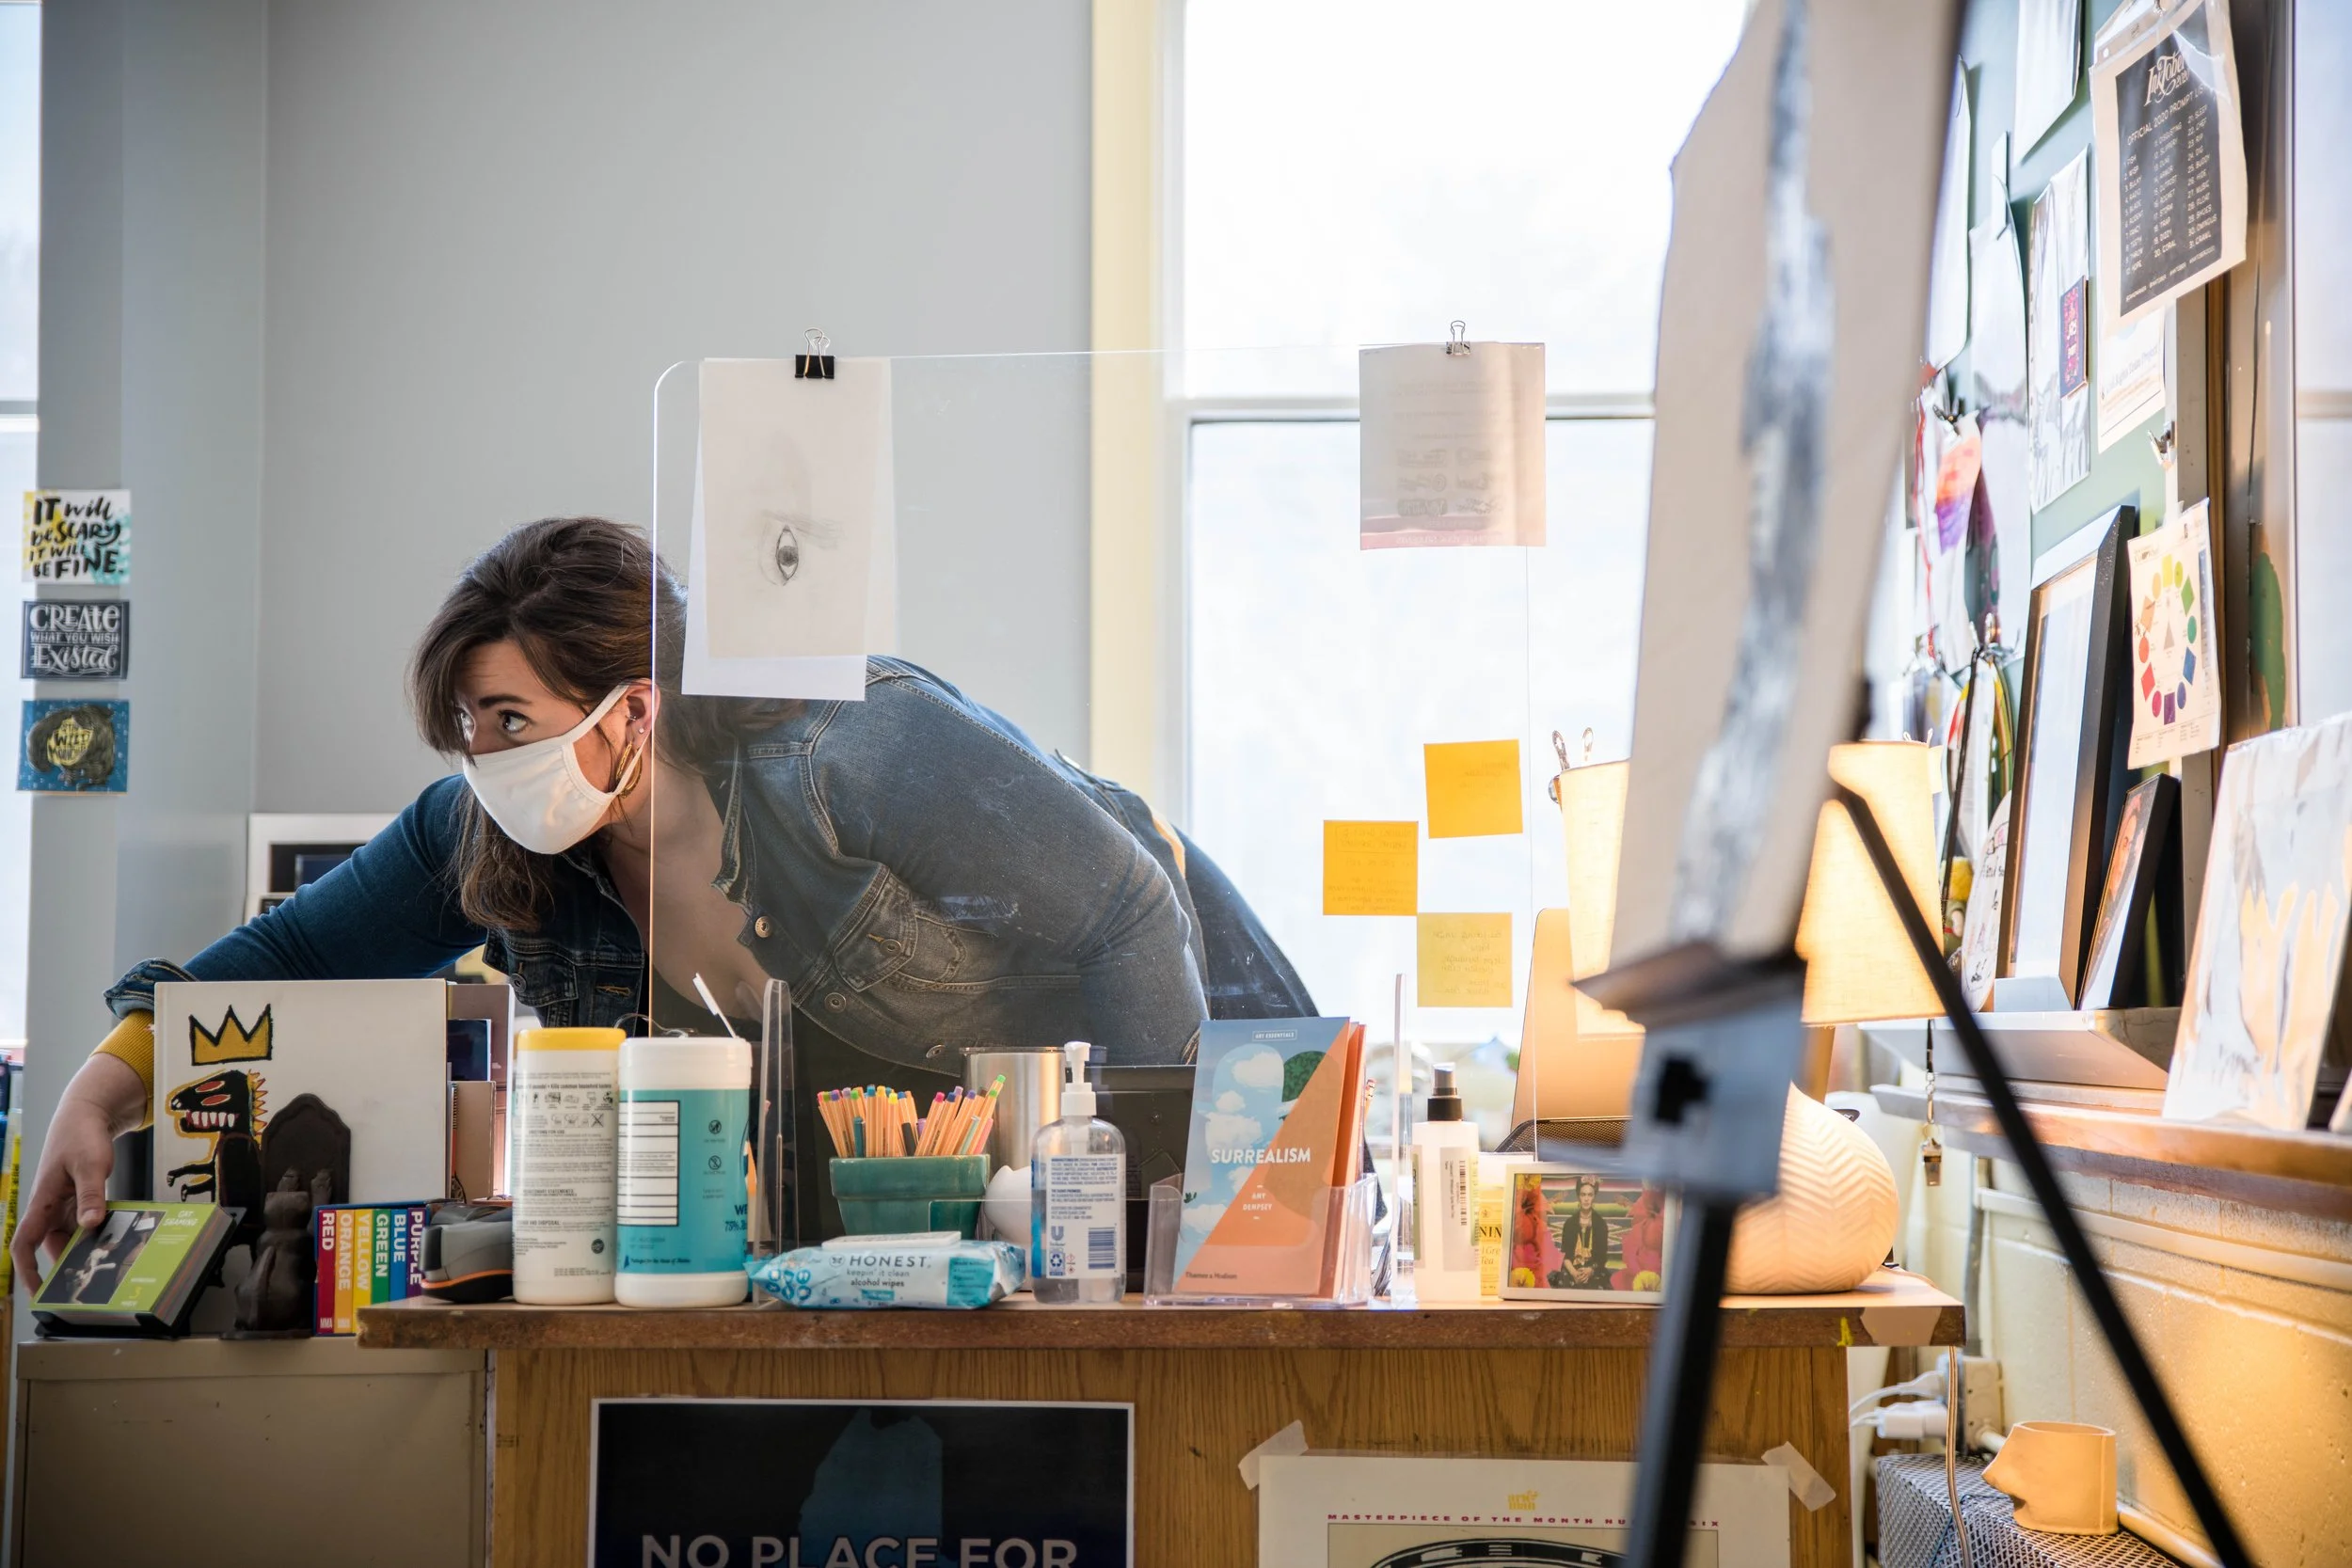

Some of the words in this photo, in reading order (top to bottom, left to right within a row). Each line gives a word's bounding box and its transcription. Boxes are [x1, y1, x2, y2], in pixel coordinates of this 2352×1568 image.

[2127, 124, 2153, 145] OFFICIAL
[2153, 111, 2169, 128] 2020
[2169, 95, 2193, 116] PROMPT
[2162, 240, 2176, 253] CORAL
[34, 497, 61, 526] IT
[64, 496, 113, 520] will
[29, 547, 45, 562] IT
[33, 562, 51, 578] BE
[30, 631, 61, 643] WHAT
[65, 632, 87, 644] YOU
[91, 632, 119, 644] WISH
[30, 643, 119, 671] Existed
[1211, 1147, 1311, 1164] SURREALISM
[1251, 1192, 1265, 1200] AMY
[1242, 1203, 1273, 1212] DEMPSEY
[322, 1212, 335, 1251] RED
[393, 1213, 406, 1263] BLUE
[338, 1213, 353, 1291] ORANGE
[357, 1212, 371, 1291] YELLOW
[375, 1213, 389, 1277] GREEN
[887, 1269, 911, 1277] clean
[850, 1277, 881, 1287] alcohol
[882, 1278, 905, 1288] wipes
[1327, 1513, 1452, 1522] MASTERPIECE
[641, 1534, 730, 1568] NO
[752, 1536, 938, 1568] PLACE
[959, 1538, 1078, 1568] FOR
